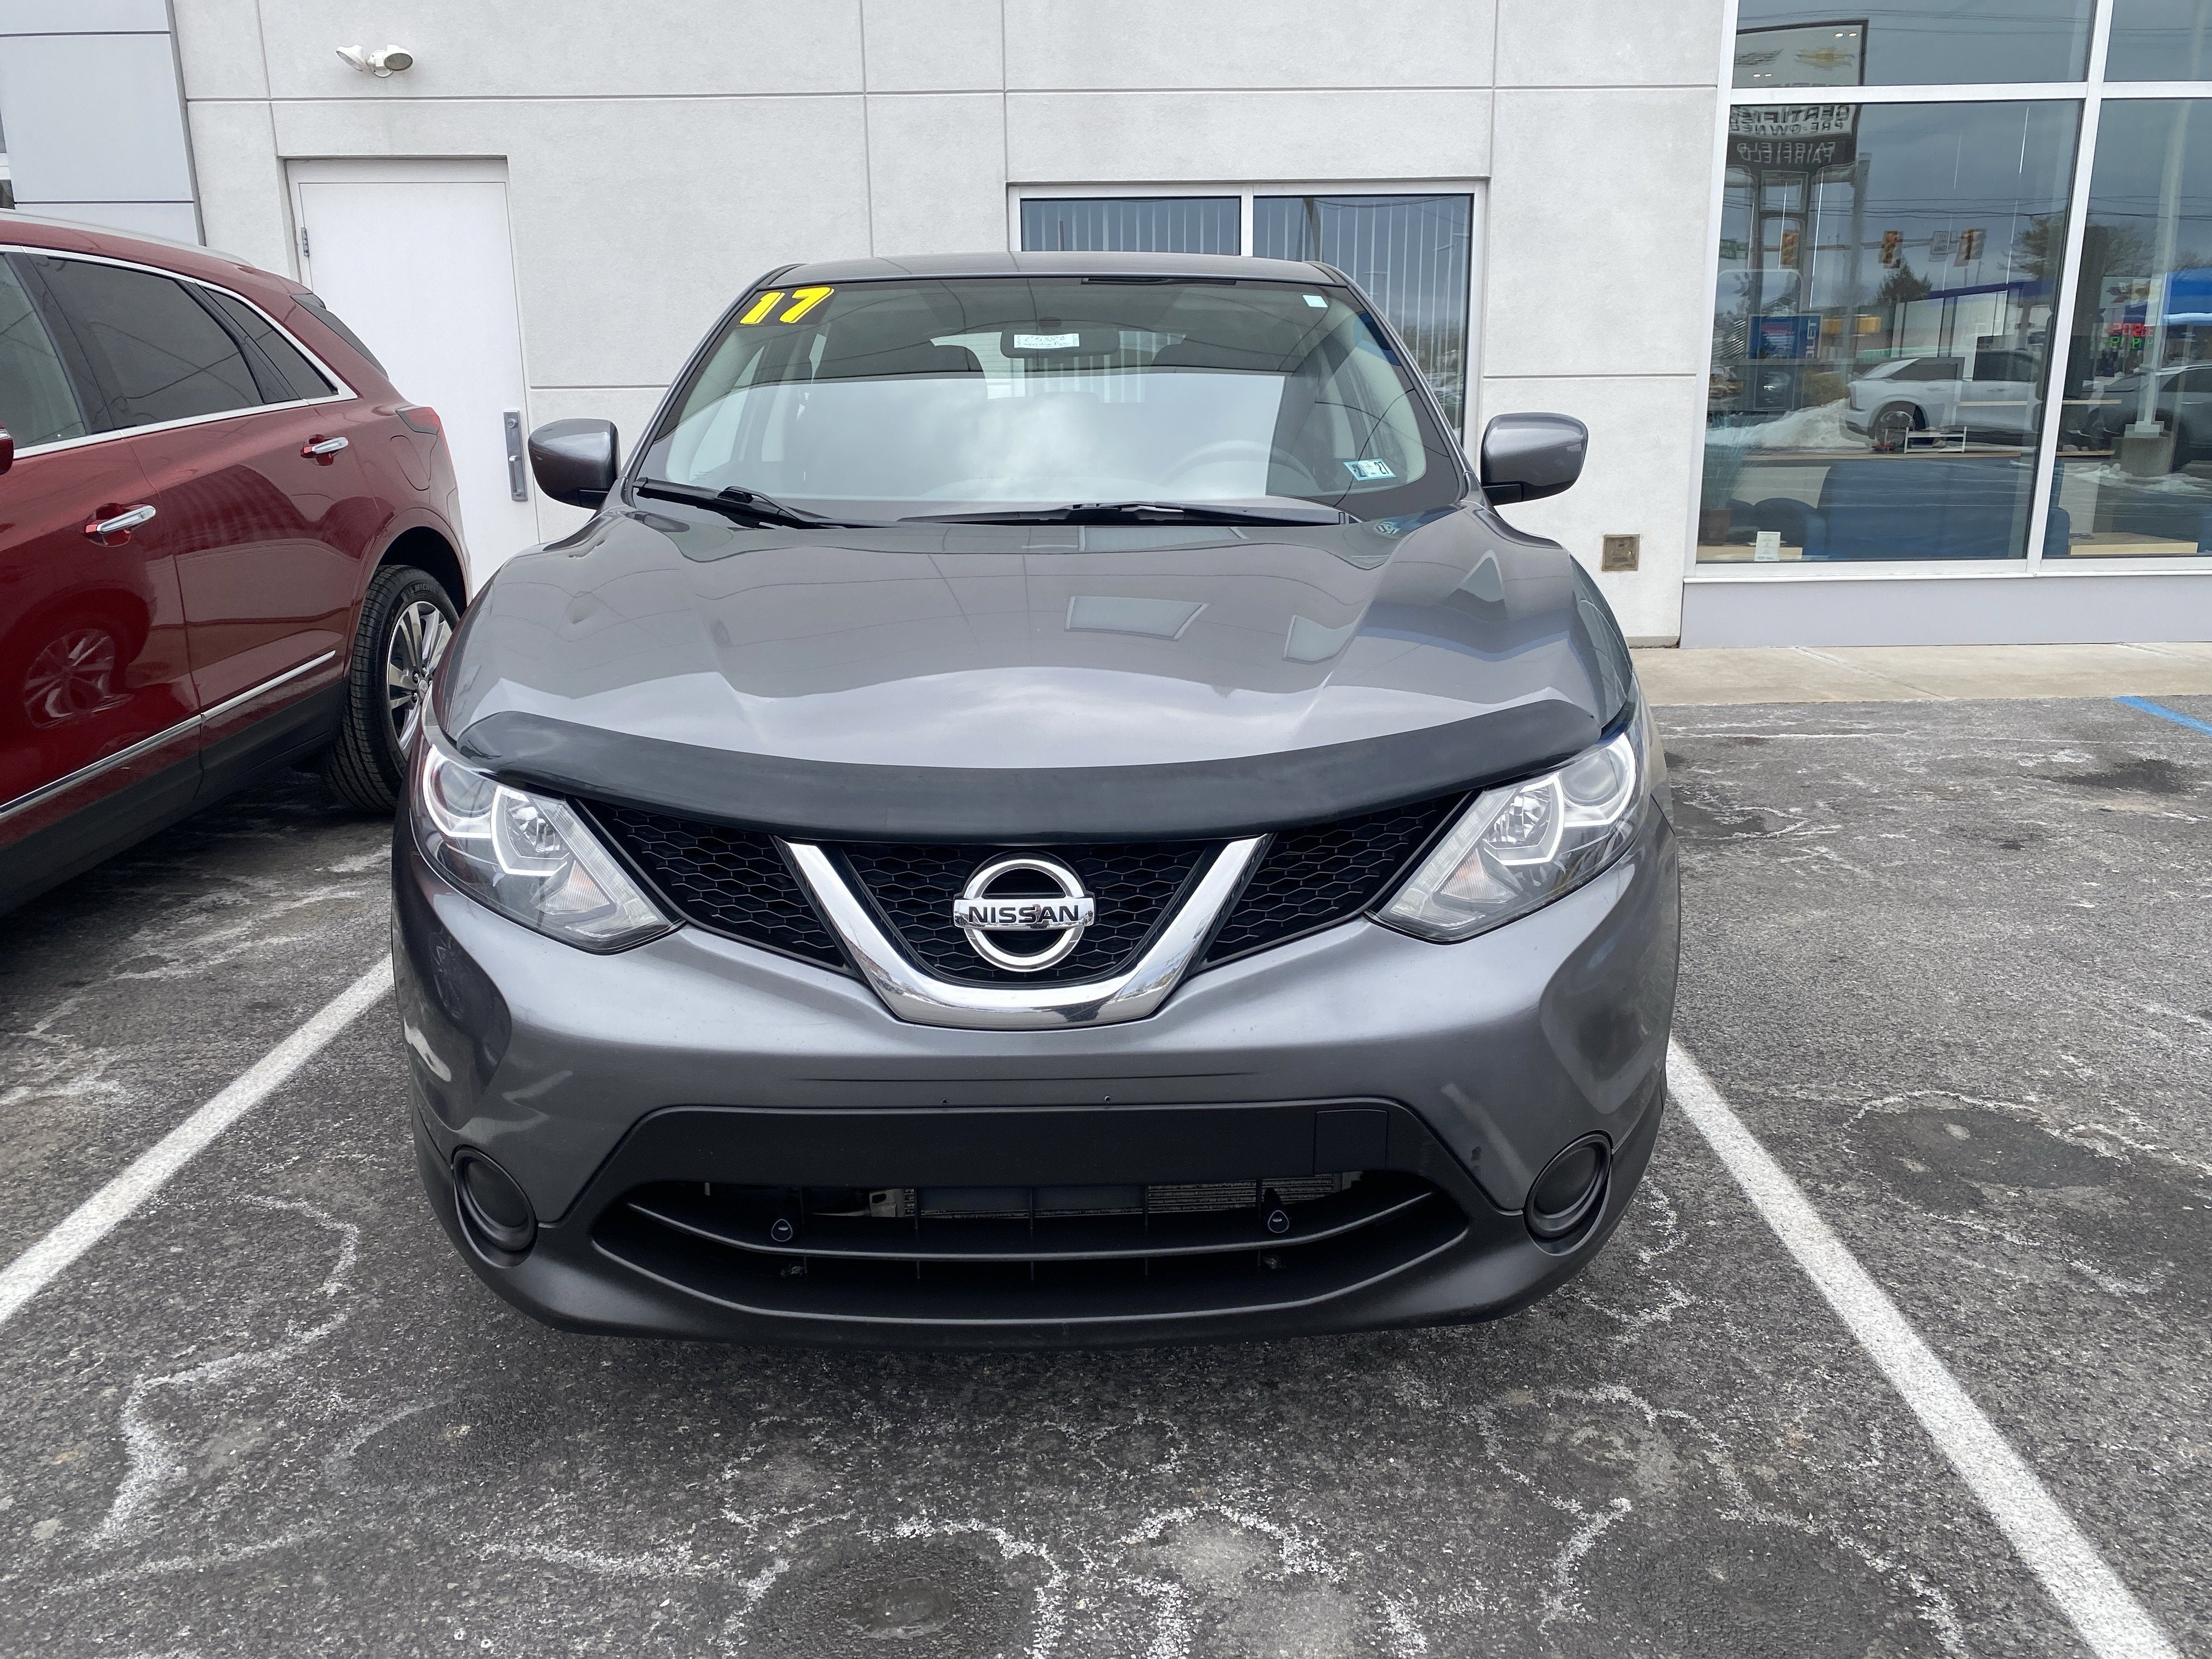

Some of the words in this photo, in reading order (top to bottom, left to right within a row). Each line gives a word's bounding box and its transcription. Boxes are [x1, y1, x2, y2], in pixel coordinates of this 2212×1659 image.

[739, 286, 835, 325] 17
[1373, 461, 1390, 475] 27
[968, 905, 1079, 924] NISSAN
